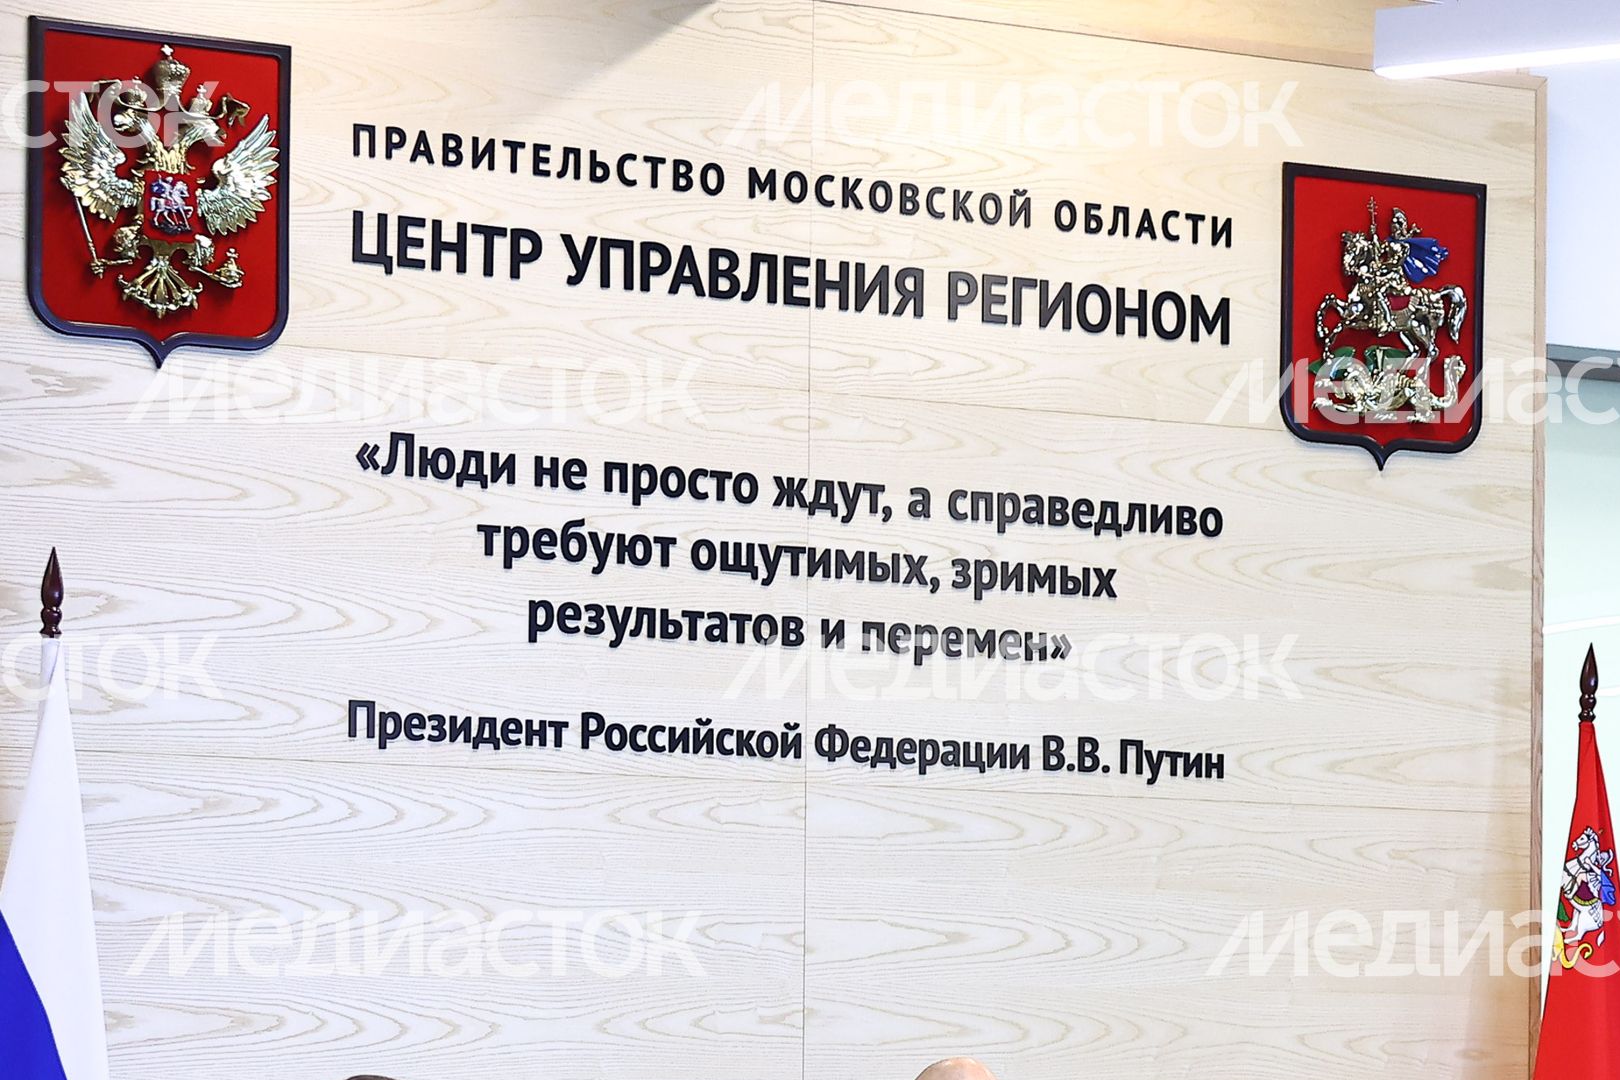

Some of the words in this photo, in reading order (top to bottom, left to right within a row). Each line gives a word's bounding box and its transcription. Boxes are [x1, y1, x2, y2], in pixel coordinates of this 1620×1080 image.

[352, 123, 725, 197] ПРАВИТЕЛЬСТВО
[748, 166, 1031, 229] МОСКОВСКОЙ
[1054, 199, 1233, 249] ОБЛАСТИ
[351, 209, 543, 280] ЦЕНТР
[559, 233, 925, 319] УПРАВЛЕНИЯ
[947, 271, 1231, 346] РЕГИОНОМ
[355, 431, 516, 490] «Люди
[534, 455, 588, 491] не
[603, 461, 759, 507] просто
[772, 475, 893, 524] ждут,
[907, 487, 931, 519] а
[947, 489, 1224, 538] справедливо
[476, 517, 678, 576] требуют
[690, 538, 941, 595] ощутимых,
[951, 558, 1118, 601] зримых
[528, 599, 805, 649] результатов
[820, 618, 845, 650] и
[861, 620, 1072, 667] перемен»
[347, 699, 570, 751] Президент
[580, 711, 802, 760] Российской
[814, 723, 1030, 776] Федерации
[1042, 734, 1111, 774] В.В.
[1119, 738, 1225, 786] Путин
